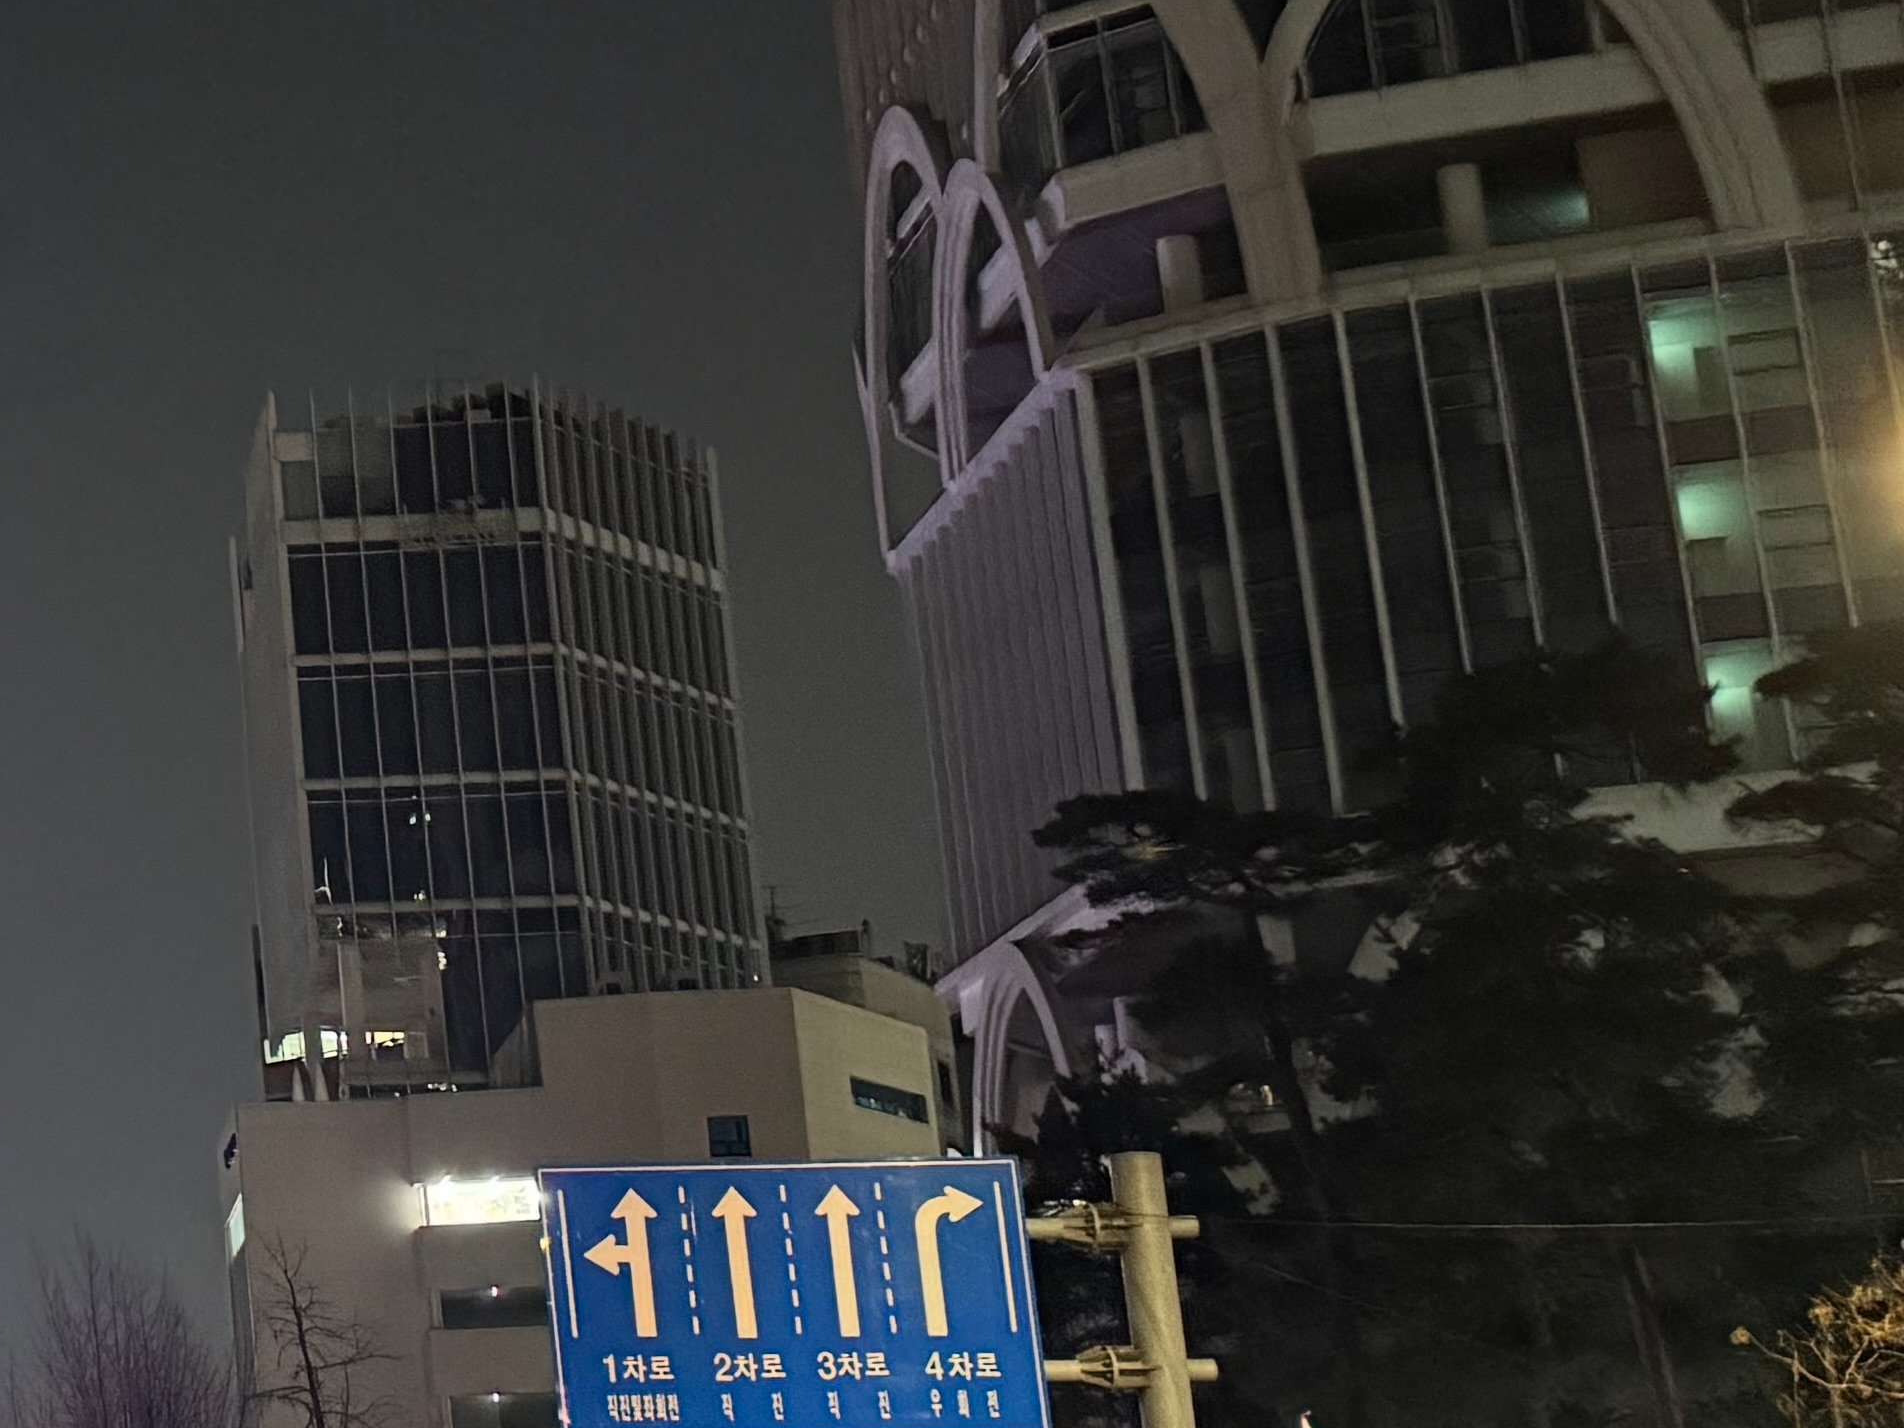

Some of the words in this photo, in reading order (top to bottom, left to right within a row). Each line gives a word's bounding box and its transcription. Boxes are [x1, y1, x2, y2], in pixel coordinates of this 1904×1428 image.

[602, 1354, 675, 1383] 1차로
[713, 1352, 787, 1383] 2차로
[817, 1351, 891, 1381] 3차로
[924, 1351, 1002, 1382] 4차로
